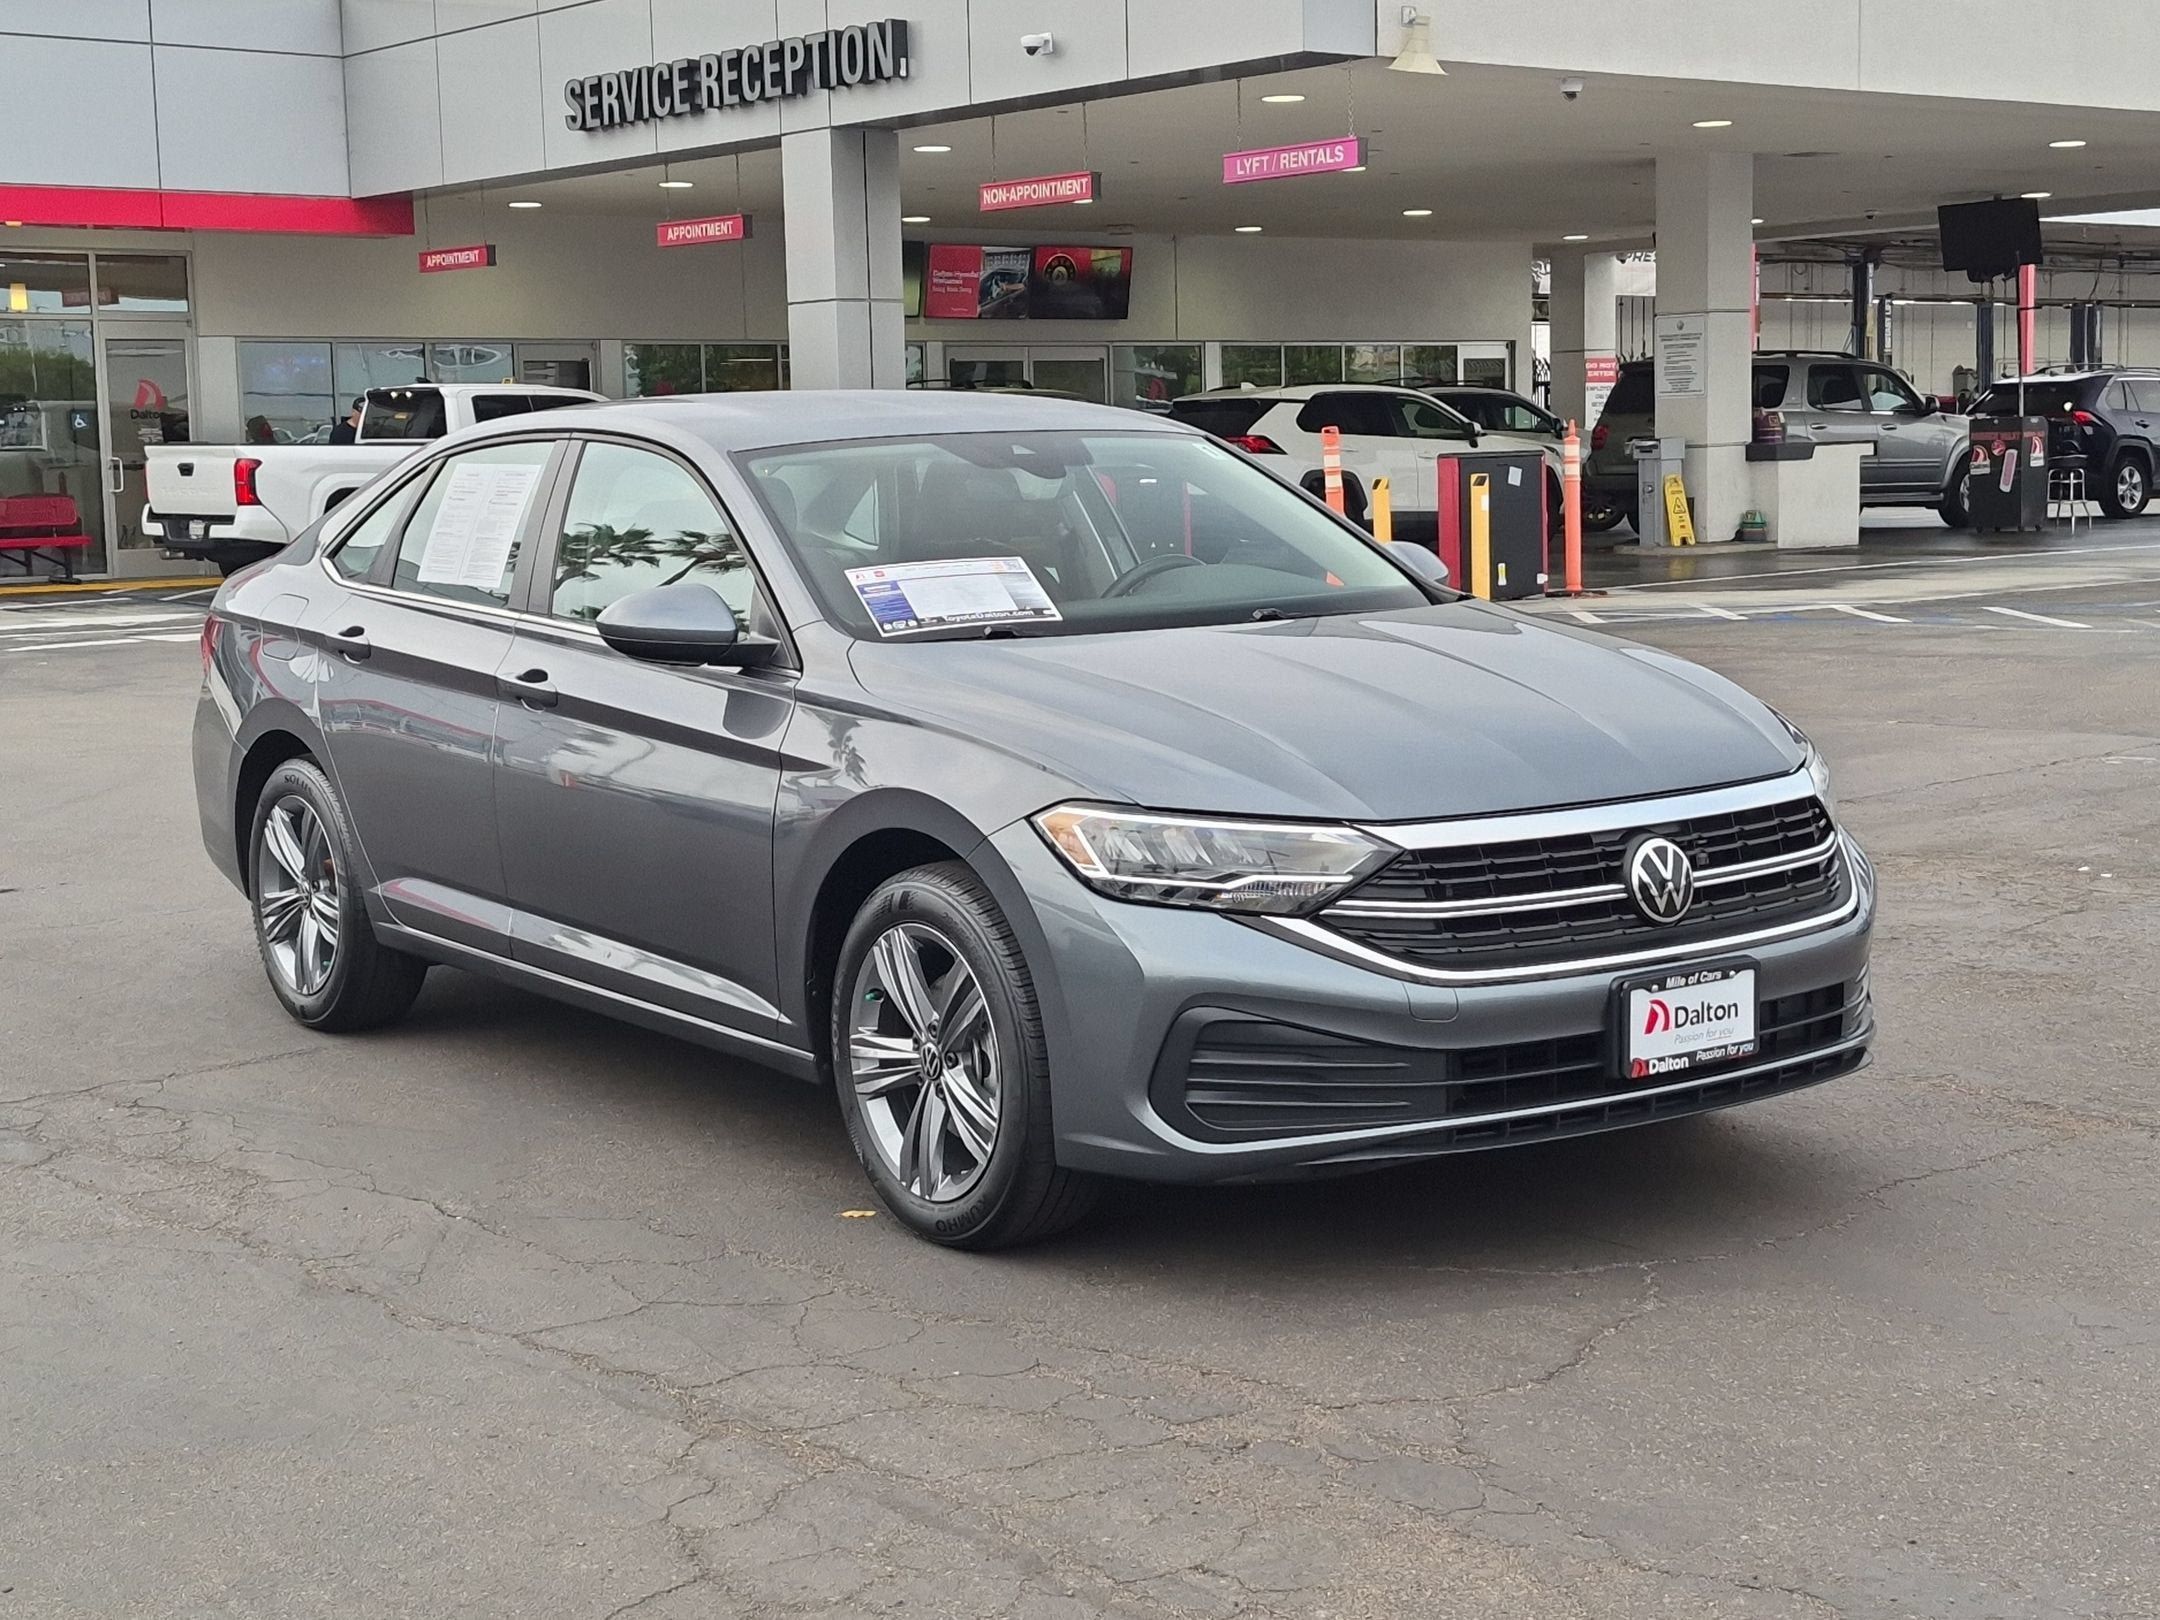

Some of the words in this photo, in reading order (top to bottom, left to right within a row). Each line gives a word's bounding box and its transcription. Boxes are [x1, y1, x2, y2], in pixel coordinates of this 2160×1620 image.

[564, 59, 690, 131] SERVICE
[1236, 155, 1268, 176] LYFT
[1279, 145, 1345, 169] RENTALS
[982, 177, 1090, 205] NON-APPOINTMENT
[665, 221, 734, 241] APPOINTMENT
[426, 249, 480, 268] APPOINTMENT
[1666, 976, 1686, 989] Mile
[1688, 973, 1699, 985] of
[1700, 970, 1722, 983] Cars
[1674, 1000, 1739, 1029] Dalton
[1673, 1031, 1705, 1045] Passion
[1705, 1028, 1718, 1041] for
[1718, 1026, 1734, 1039] you
[1695, 1047, 1726, 1062] Passion
[1726, 1044, 1739, 1057] for
[1738, 1042, 1754, 1056] you
[1648, 1056, 1689, 1075] Dalton
